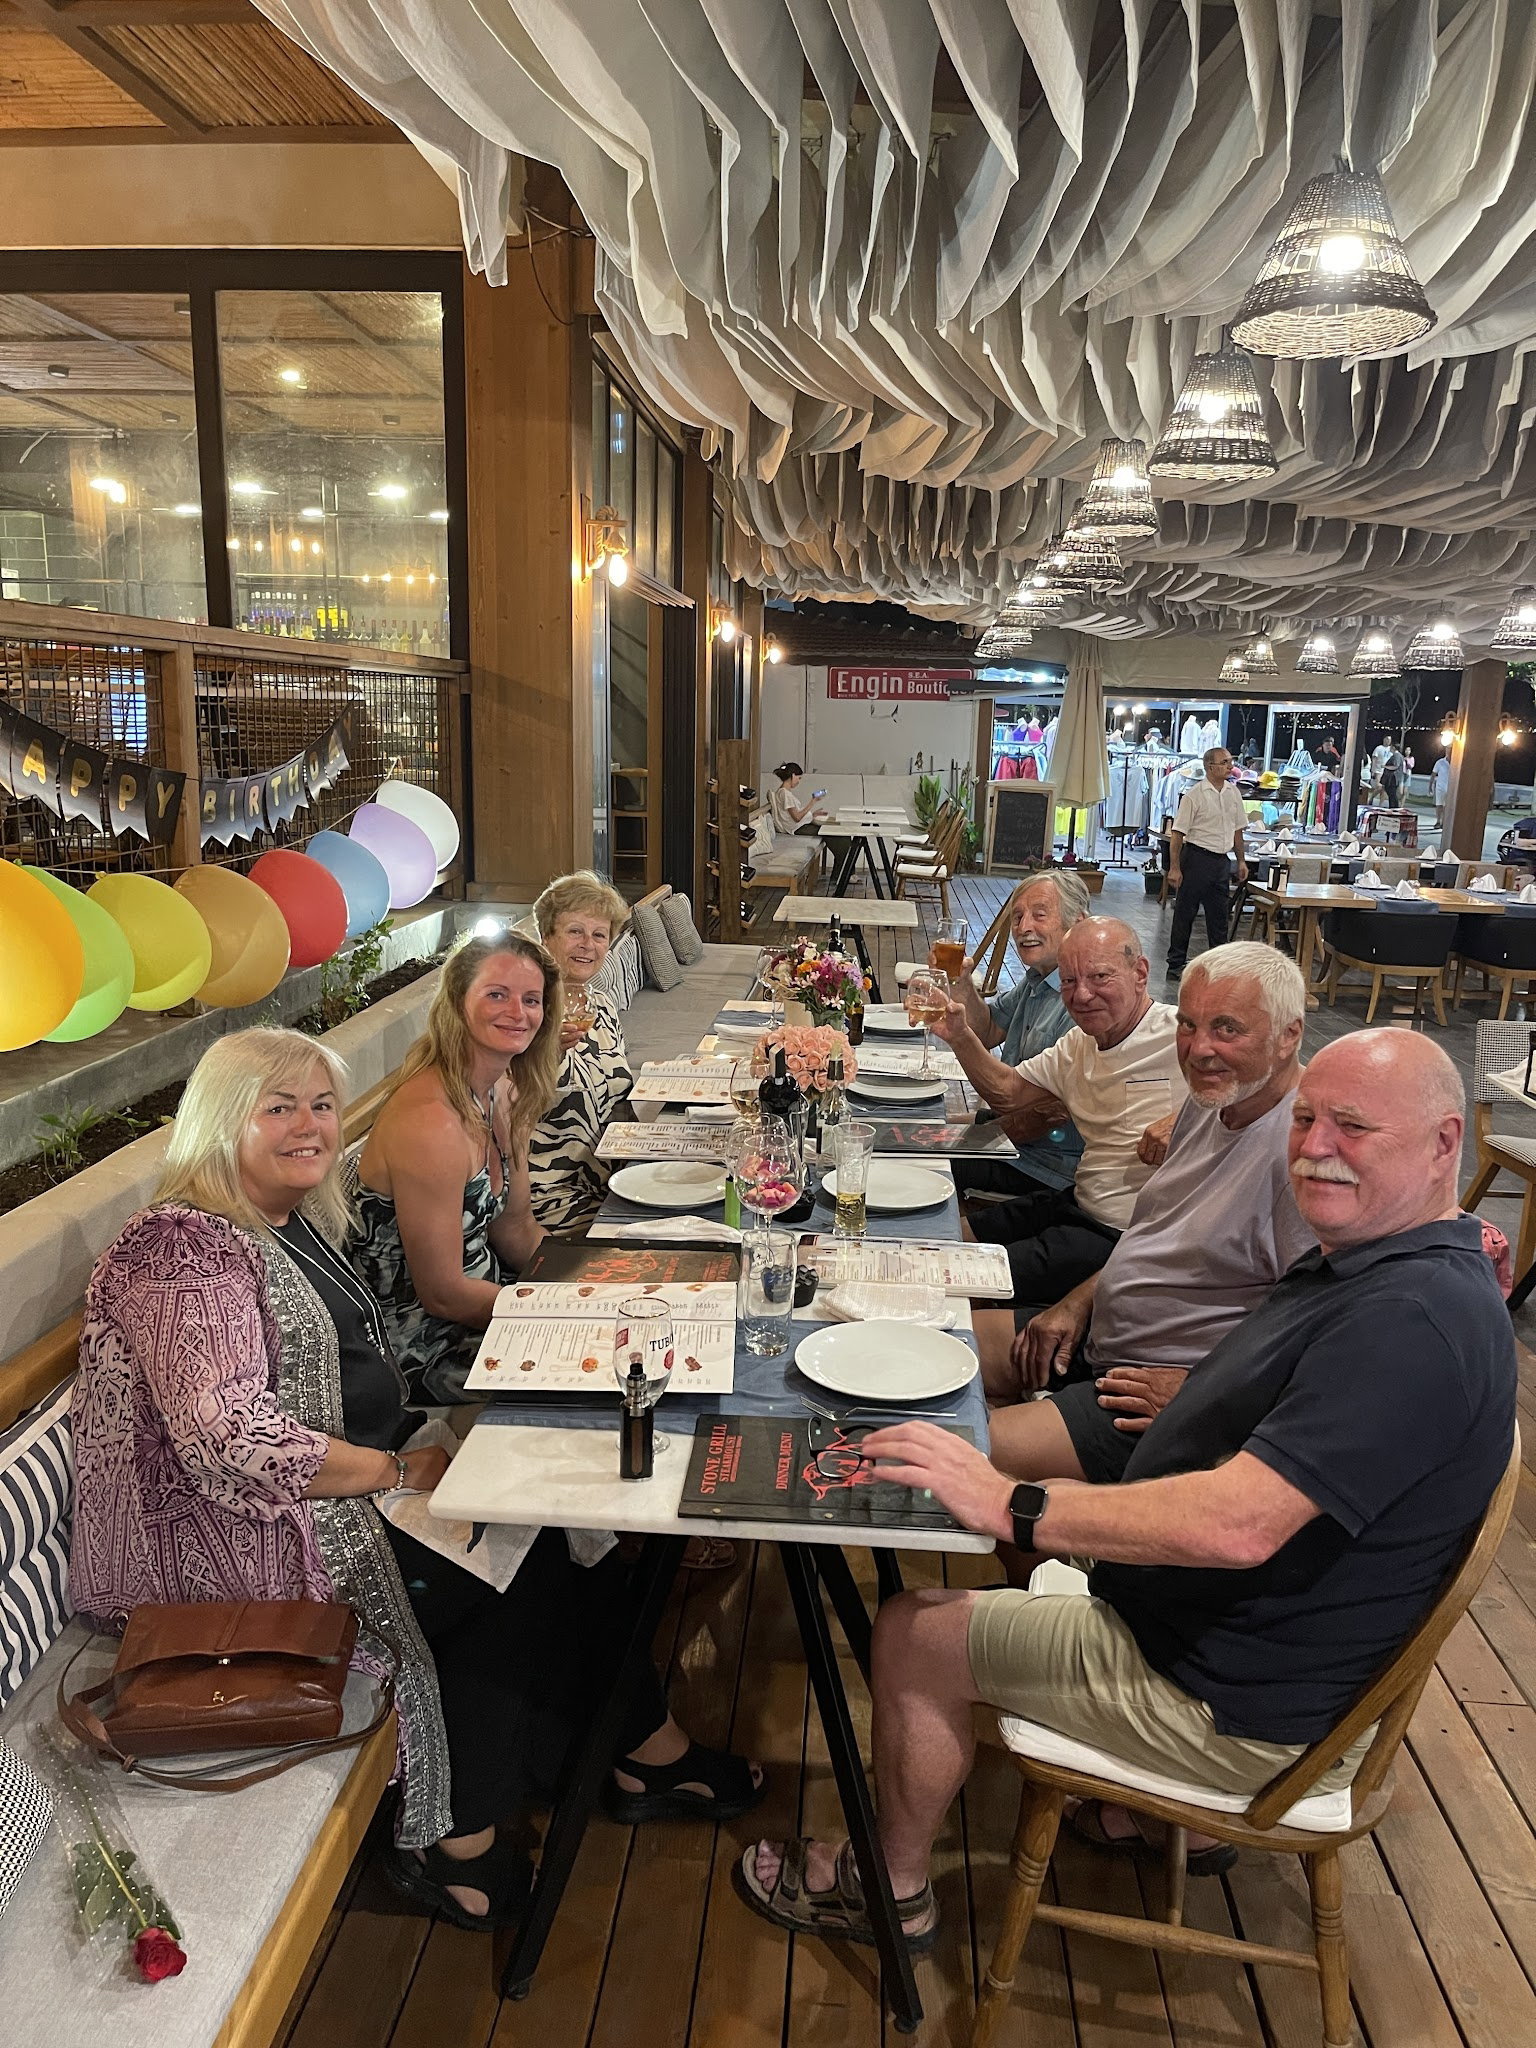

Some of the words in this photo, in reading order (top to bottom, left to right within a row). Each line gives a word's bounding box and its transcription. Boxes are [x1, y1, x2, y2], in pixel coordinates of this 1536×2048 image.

[837, 671, 903, 700] Engin
[0, 716, 176, 820] APPY
[203, 711, 352, 823] BIRTHDAY
[708, 1423, 728, 1455] GRILL
[780, 1432, 793, 1456] MENU
[700, 1457, 721, 1495] STONE
[719, 1435, 737, 1482] STEAKHOUSE
[775, 1456, 792, 1491] DINNER
